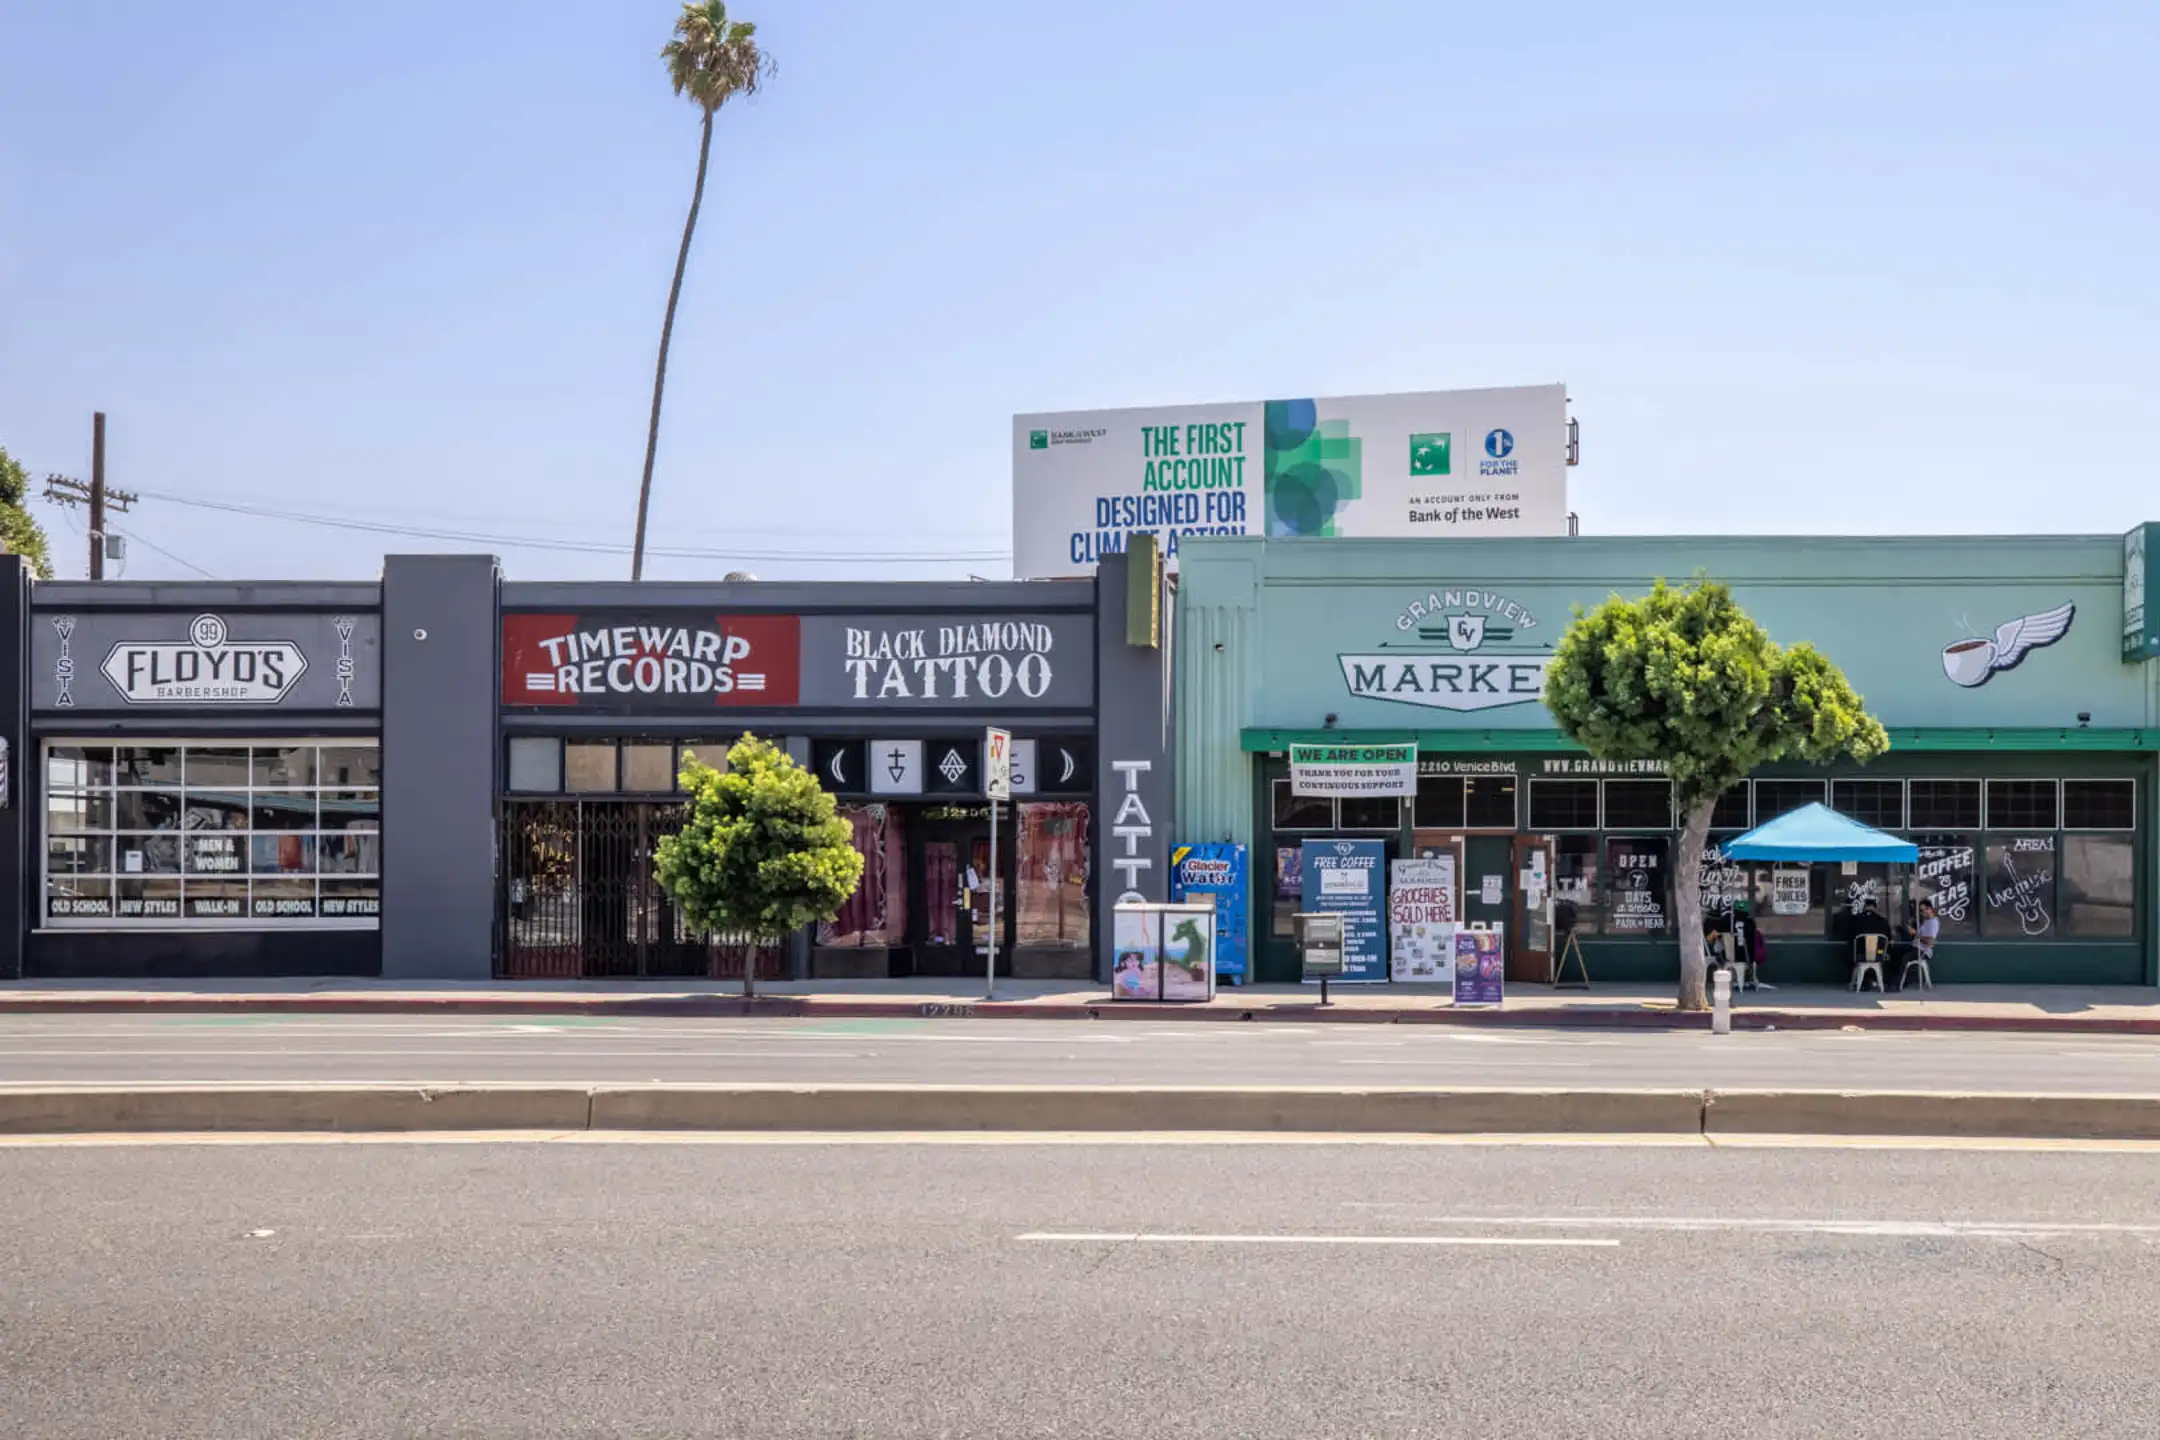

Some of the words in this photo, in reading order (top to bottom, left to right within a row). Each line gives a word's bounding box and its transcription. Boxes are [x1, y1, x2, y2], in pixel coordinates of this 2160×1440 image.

[1141, 426, 1181, 457] THE
[1187, 421, 1246, 455] FIRST
[1143, 456, 1246, 491] ACCOUNT
[1480, 467, 1519, 476] PLANET
[1424, 495, 1465, 504] ACCOUNT
[1494, 493, 1520, 501] FROM
[1096, 493, 1199, 528] DESIGNED
[1205, 491, 1246, 523] FOR
[1409, 509, 1441, 523] Bank
[1444, 507, 1459, 523] of
[1461, 507, 1484, 520] the
[1486, 506, 1520, 520] West
[1070, 530, 1159, 563] CLIM
[1396, 590, 1537, 631] GRANDVIEW
[200, 622, 218, 641] 99
[538, 626, 751, 667] TIMEWARP
[845, 626, 927, 660] BLACK
[938, 622, 1053, 656] DIAMOND
[56, 626, 74, 706] VISTA
[127, 651, 284, 692] FLOYD'S
[337, 626, 353, 706] VISTA
[557, 656, 734, 694] RECORDS
[845, 652, 1053, 698] TATTOO
[1353, 664, 1541, 693] MARKE
[156, 687, 248, 697] BARBERSHOP
[1297, 749, 1323, 761] WE
[1326, 749, 1358, 761] ARE
[1362, 748, 1407, 761] OPEN
[1299, 769, 1332, 777] THANK
[1333, 769, 1353, 777] YOU
[1354, 769, 1374, 777] FOR
[1375, 769, 1401, 777] YOUR
[1418, 761, 1451, 773] 2210
[1453, 761, 1490, 773] Venice
[1299, 781, 1360, 790] CONTINUOUS
[1361, 780, 1405, 789] SUPPORT
[1111, 760, 1152, 904] TATT
[199, 839, 222, 852] MEN
[196, 856, 239, 871] WOMEN
[1188, 860, 1230, 872] Glacier
[1313, 856, 1338, 869] FREE
[1339, 856, 1377, 868] COFFEE
[1619, 854, 1658, 868] OPEN
[1918, 850, 1973, 880] COFFEE
[1182, 871, 1234, 884] Water
[1624, 891, 1653, 904] DAYS
[1927, 881, 1969, 909] TEAS
[51, 899, 71, 913] OLD
[72, 899, 110, 913] SCHOOL
[120, 899, 143, 913] NEW
[144, 899, 178, 913] STYLES
[194, 899, 240, 914] WALK-IN
[255, 900, 274, 914] OLD
[275, 899, 313, 914] SCHOOL
[323, 900, 345, 913] NEW
[346, 900, 380, 913] STYLES
[1392, 904, 1423, 924] SOLD
[1424, 904, 1452, 924] HERE
